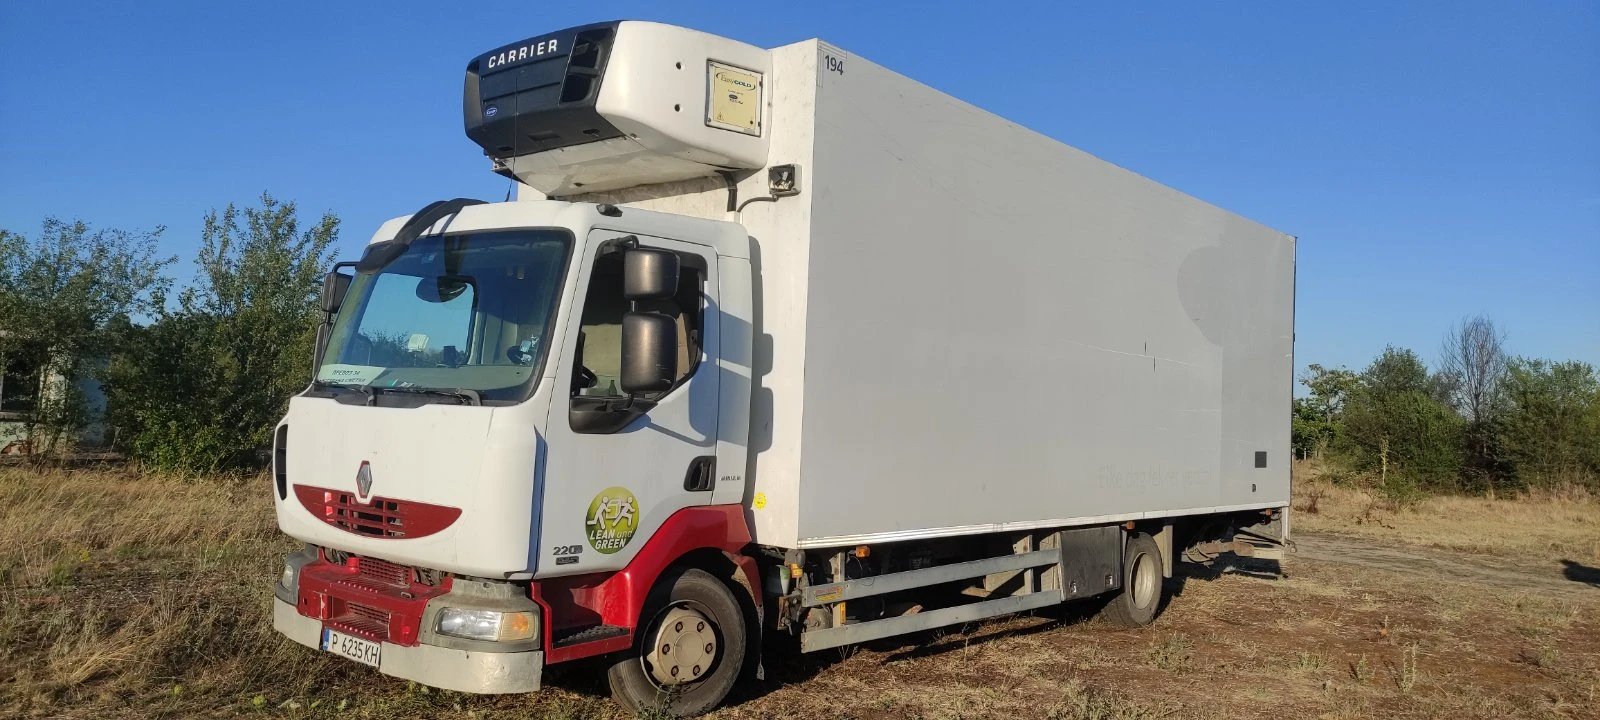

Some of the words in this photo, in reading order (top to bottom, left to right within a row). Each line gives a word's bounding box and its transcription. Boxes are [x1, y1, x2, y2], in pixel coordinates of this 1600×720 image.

[488, 39, 558, 68] CARRIER
[825, 54, 844, 75] 194
[590, 529, 616, 541] LEAN
[617, 528, 634, 538] and
[553, 545, 575, 556] 220
[595, 539, 626, 550] GREEN
[332, 634, 338, 650] P
[342, 637, 363, 659] 6235
[364, 643, 379, 664] KH
